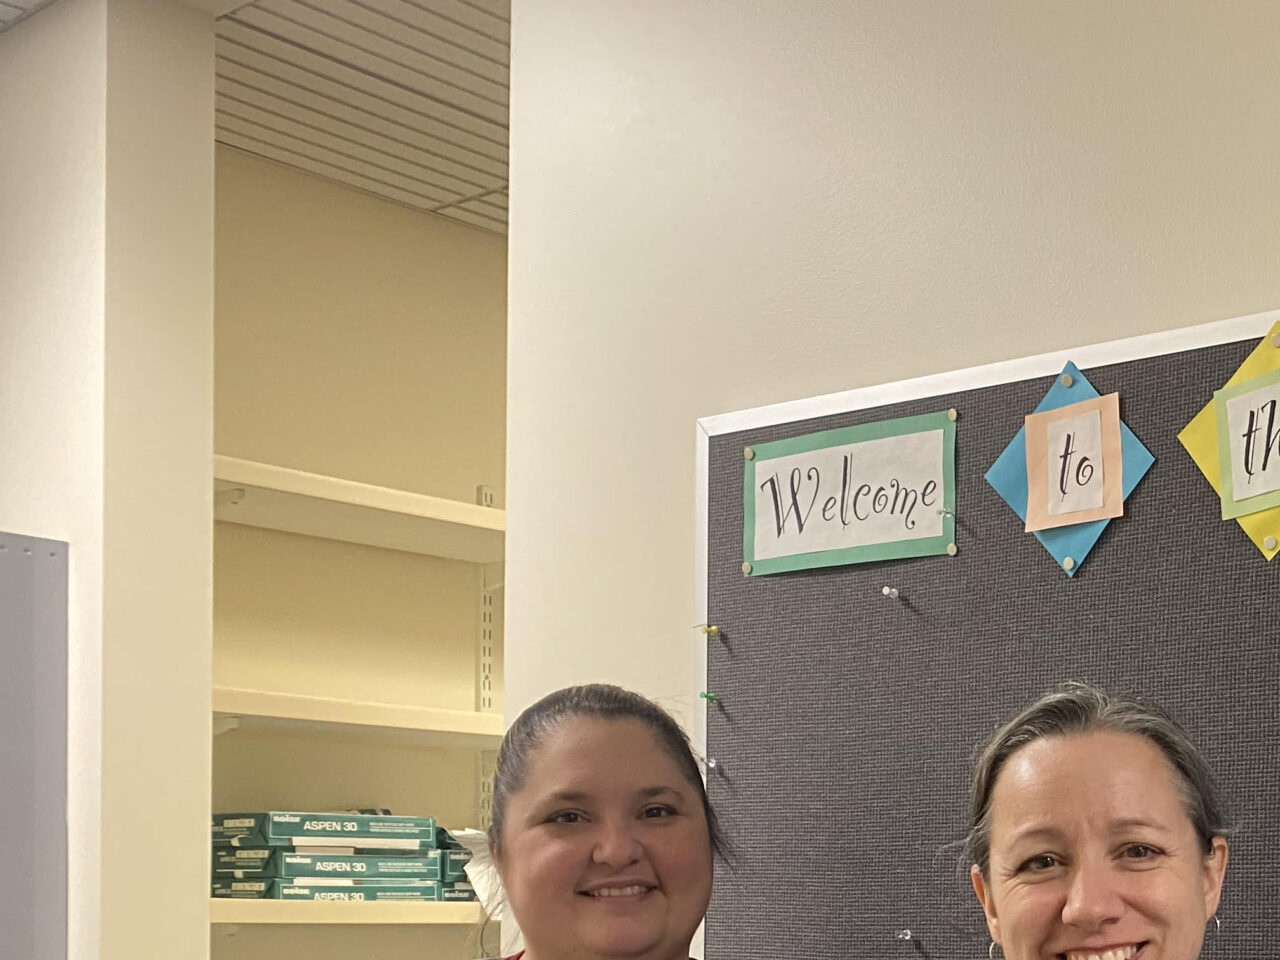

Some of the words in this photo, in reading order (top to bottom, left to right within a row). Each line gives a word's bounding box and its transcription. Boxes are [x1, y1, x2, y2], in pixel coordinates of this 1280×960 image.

[760, 454, 937, 539] Welcome
[1059, 432, 1094, 496] to
[303, 821, 341, 832] ASPEN
[343, 821, 358, 832] 30
[315, 862, 351, 872] ASPEN
[353, 862, 366, 872] 30
[314, 892, 348, 901] ASPEN
[350, 893, 365, 901] 30
